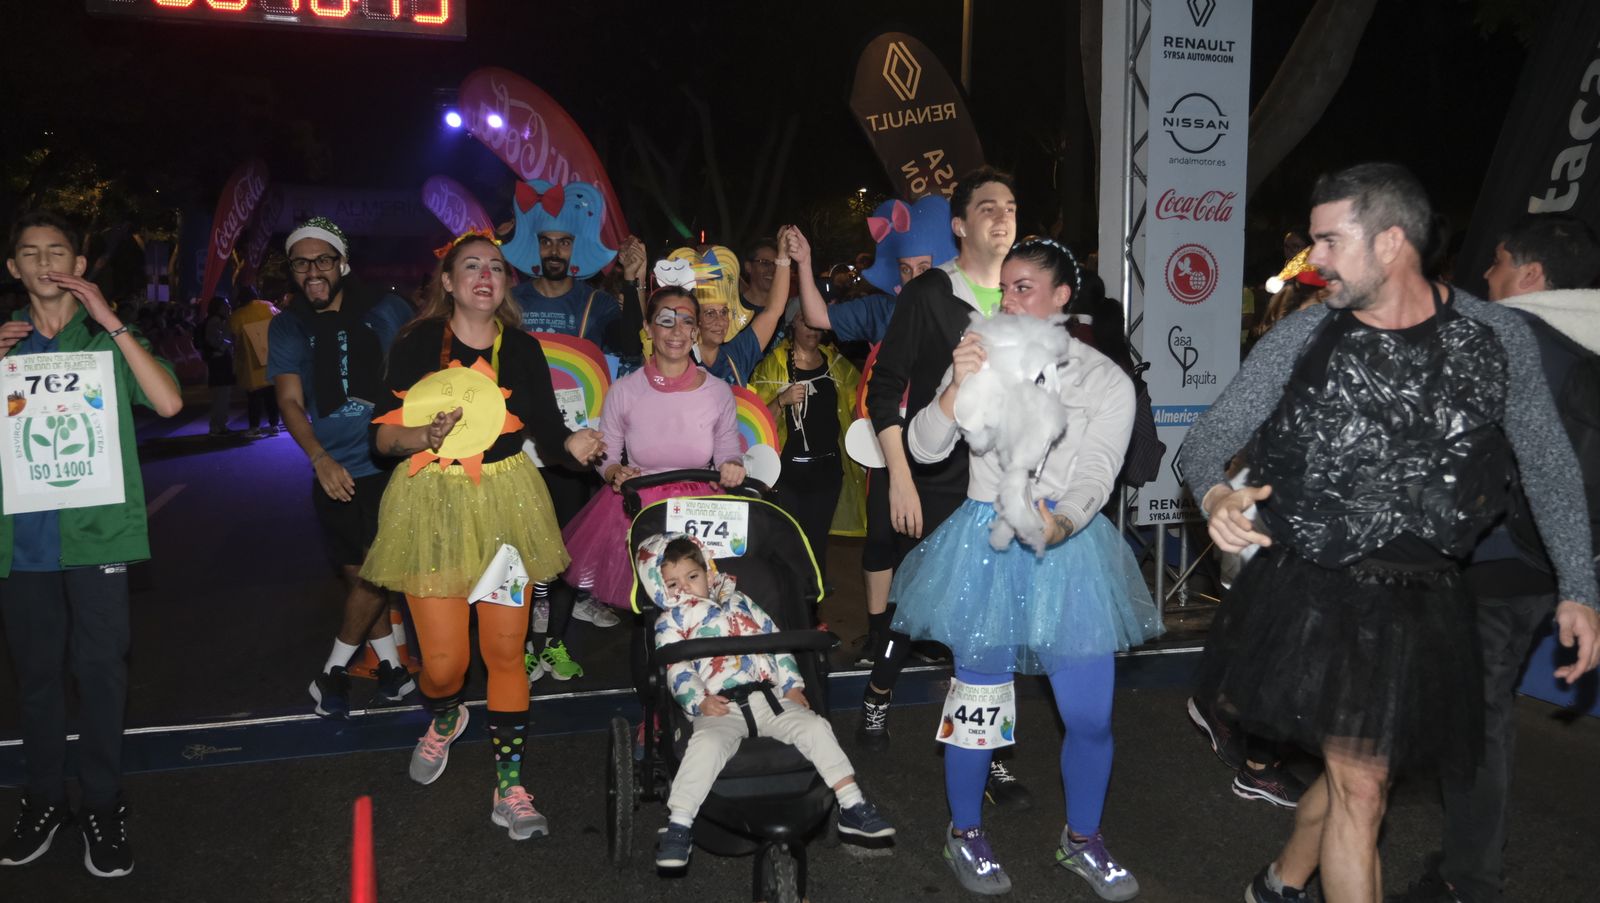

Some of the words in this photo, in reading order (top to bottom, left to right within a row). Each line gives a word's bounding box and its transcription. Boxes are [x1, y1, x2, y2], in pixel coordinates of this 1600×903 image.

[1163, 36, 1236, 52] RENAULT
[1163, 50, 1185, 59] SYRSA
[1187, 52, 1234, 63] AUTOMOCION
[1163, 117, 1229, 130] NISSAN
[1169, 157, 1226, 166] andalmotor.es
[1182, 347, 1217, 389] Paquita
[25, 373, 81, 394] 762
[1154, 409, 1199, 423] Almerica
[30, 464, 50, 480] ISO
[56, 460, 93, 478] 14001
[685, 520, 729, 539] 674
[954, 705, 1000, 726] 447
